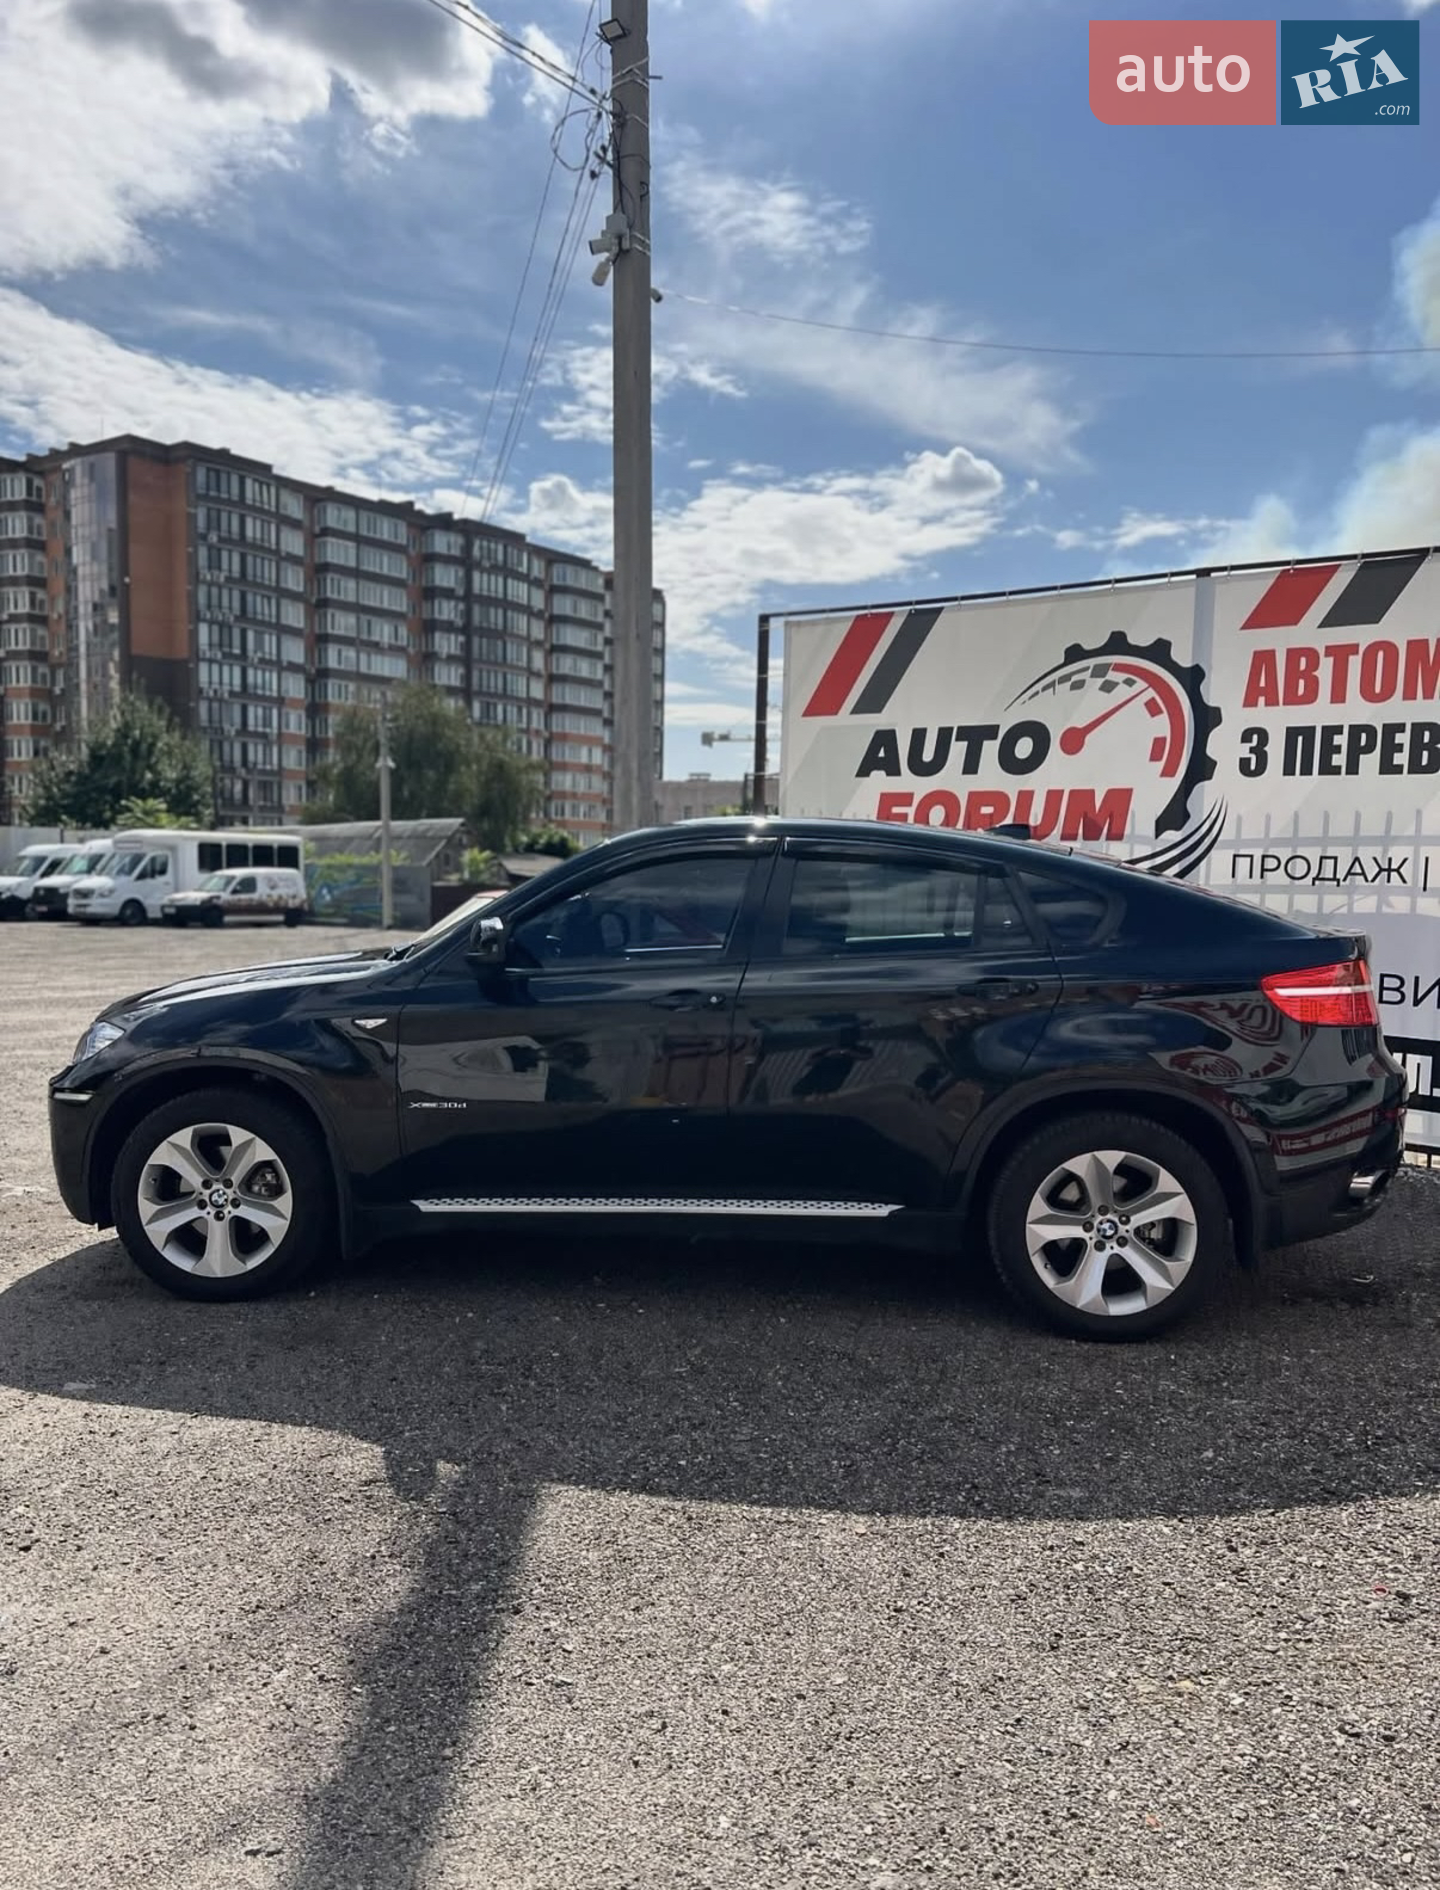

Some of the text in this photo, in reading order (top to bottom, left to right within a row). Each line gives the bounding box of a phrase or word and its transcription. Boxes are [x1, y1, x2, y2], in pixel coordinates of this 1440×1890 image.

[1242, 637, 1440, 708] АВТОМ
[855, 720, 1051, 777] AUTO
[1282, 721, 1440, 777] ПЕРЕВ
[876, 787, 1133, 841] FORUM
[1231, 853, 1408, 888] ПРОДАЖ
